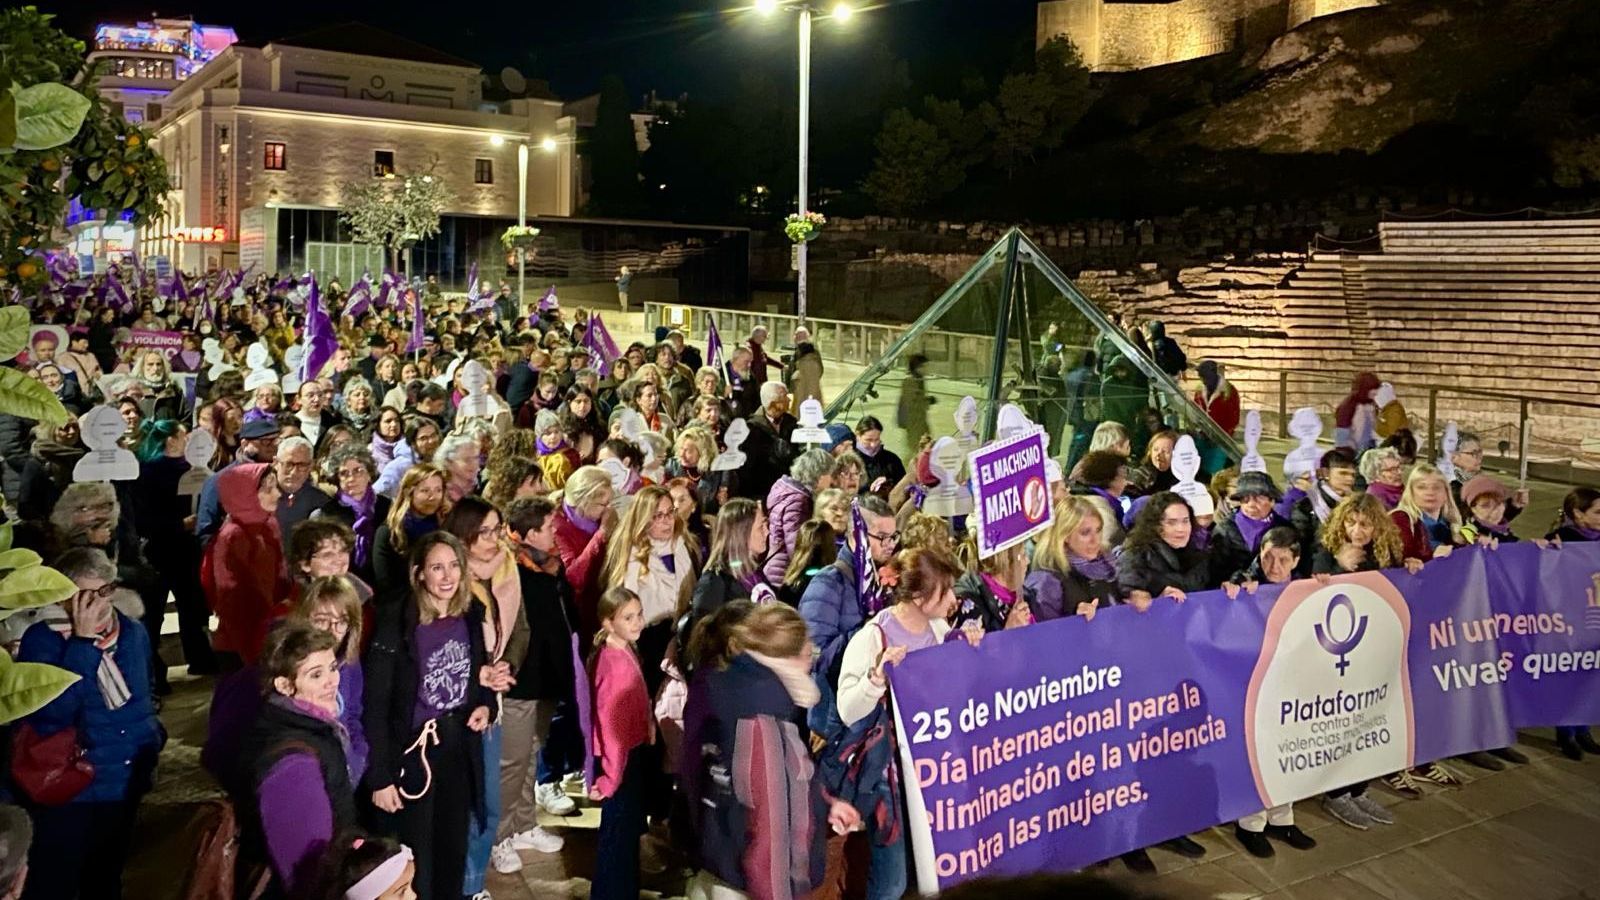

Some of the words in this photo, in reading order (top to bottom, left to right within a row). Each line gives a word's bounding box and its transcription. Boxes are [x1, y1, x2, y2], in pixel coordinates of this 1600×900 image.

[173, 226, 227, 242] CINES
[980, 464, 995, 486] EL
[993, 444, 1040, 481] MACHISMO
[985, 485, 1022, 525] MATA
[1430, 616, 1457, 651] Ni
[1522, 650, 1600, 680] quere
[912, 707, 952, 744] 25
[959, 698, 990, 733] de
[994, 664, 1122, 721] Noviembre
[1280, 683, 1389, 725] Plataforma
[914, 752, 967, 789] Día
[972, 699, 1122, 776] Internacional
[1129, 692, 1180, 729] para
[1183, 683, 1201, 708] la
[1278, 732, 1341, 753] violencias
[1310, 717, 1350, 734] contra
[1066, 752, 1096, 782] de
[1102, 743, 1122, 768] la
[1127, 713, 1227, 761] violencia
[1278, 742, 1353, 774] VIOLENCIA
[1355, 728, 1391, 751] CERO
[935, 830, 1004, 877] ontra
[1009, 814, 1041, 849] las
[1048, 780, 1149, 833] mujeres.
